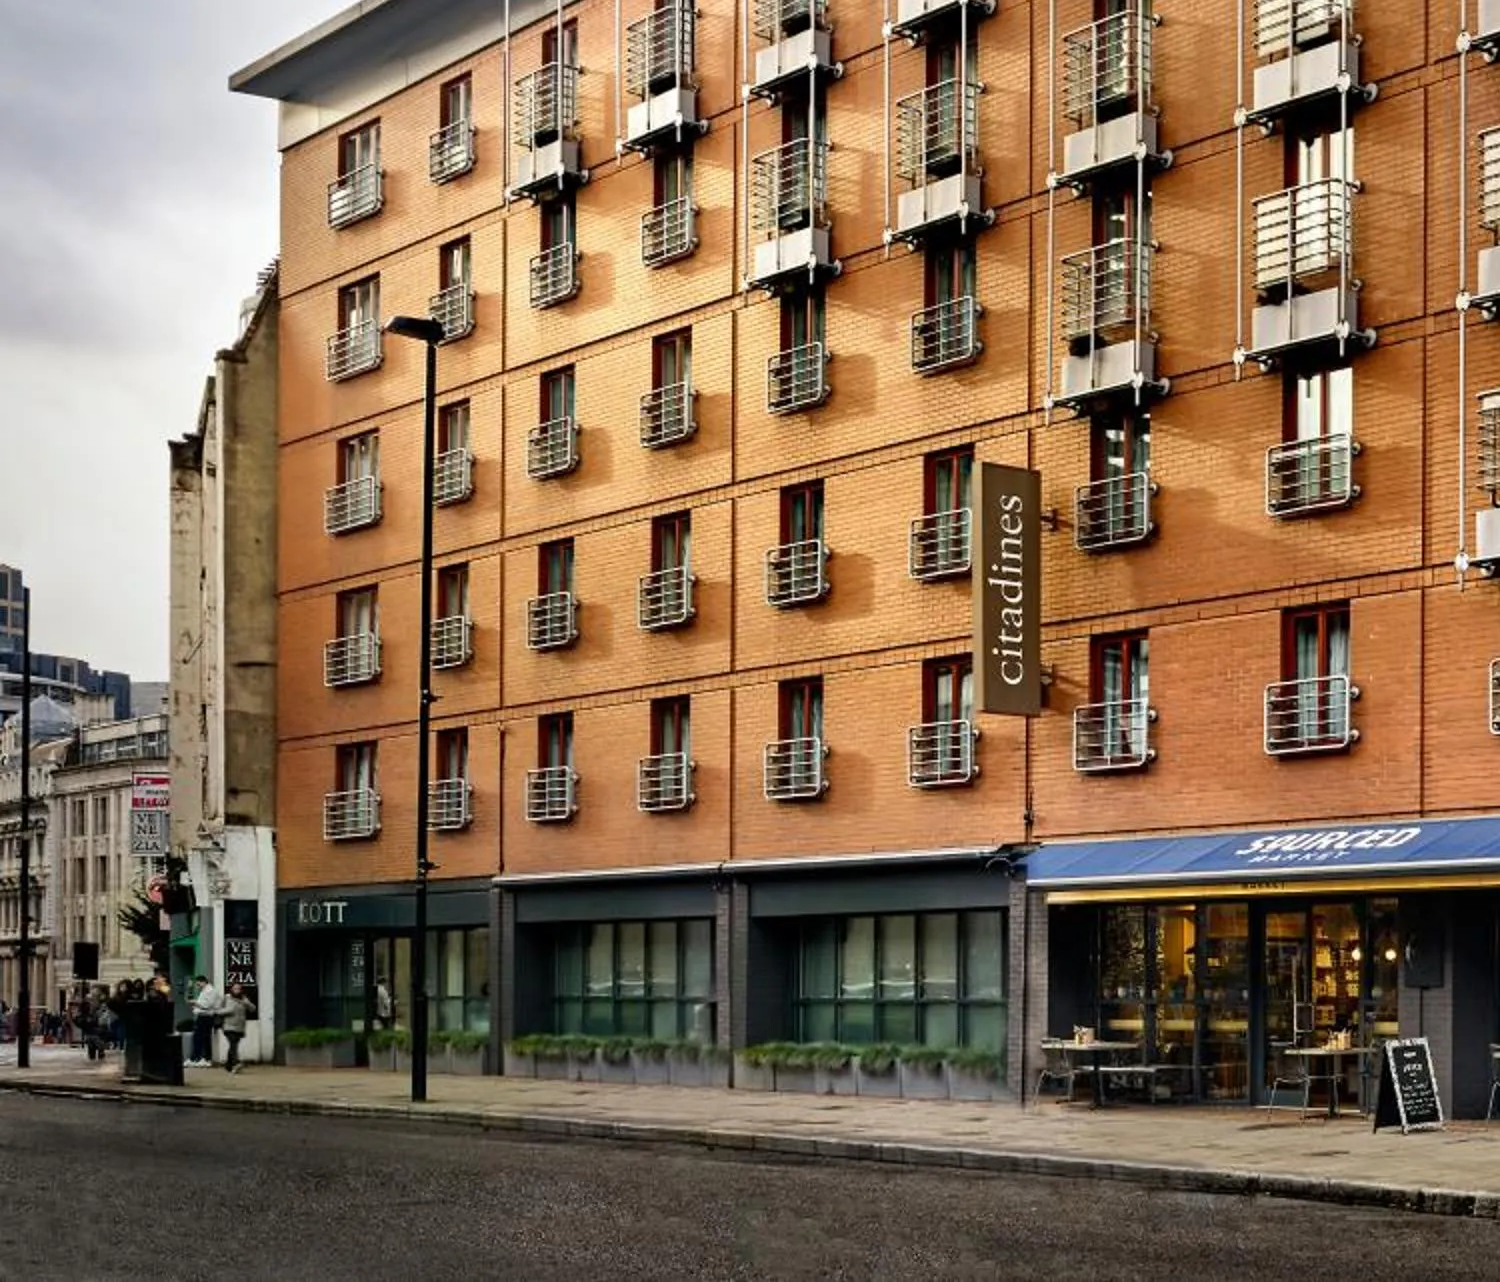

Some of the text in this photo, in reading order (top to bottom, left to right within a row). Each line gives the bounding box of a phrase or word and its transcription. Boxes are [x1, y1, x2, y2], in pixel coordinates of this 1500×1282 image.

[988, 494, 1023, 685] citadines
[1235, 827, 1421, 854] SOURCED
[230, 941, 252, 953] VE
[228, 971, 255, 983] ZIA
